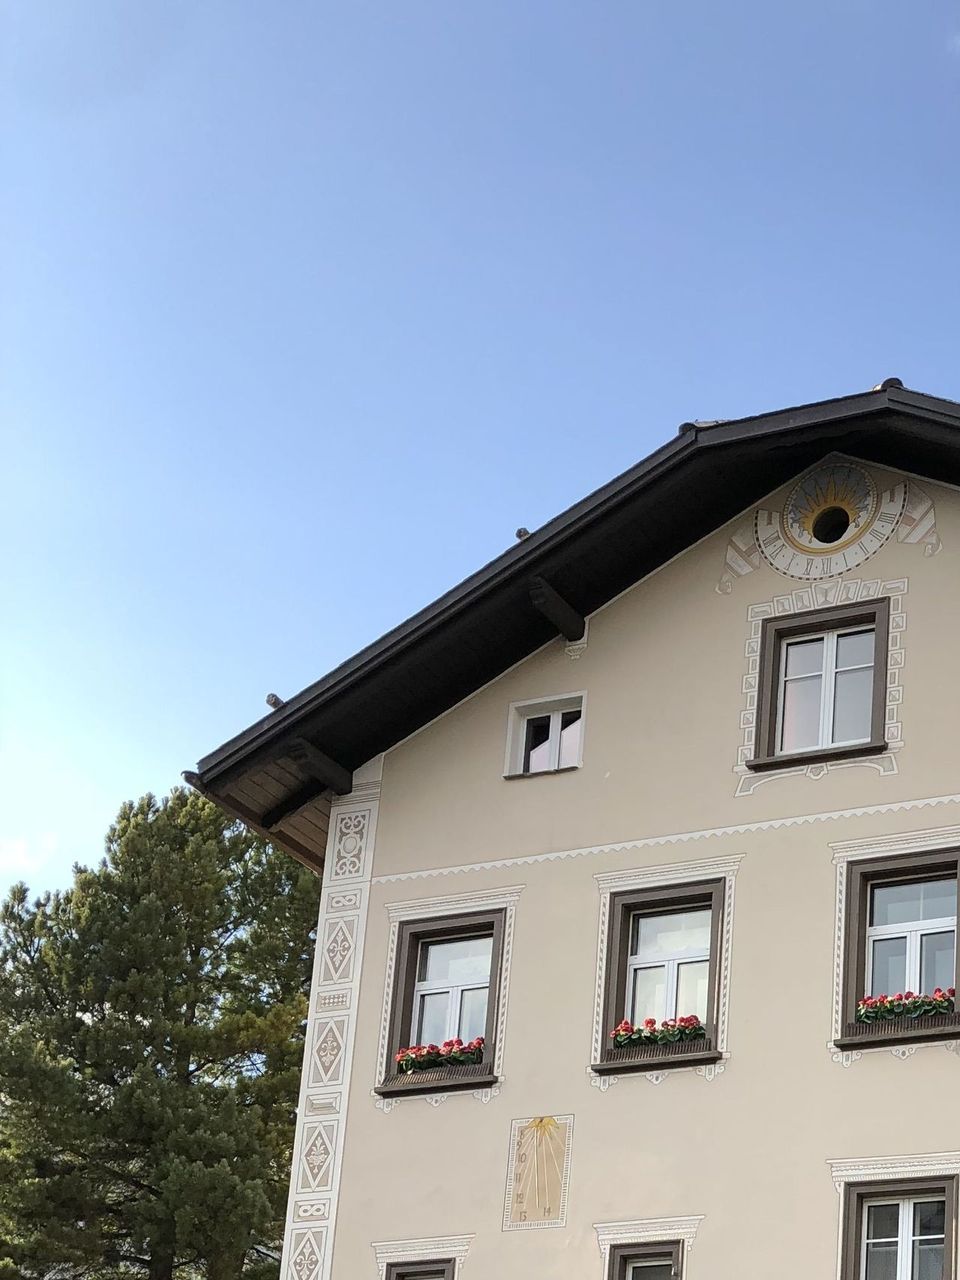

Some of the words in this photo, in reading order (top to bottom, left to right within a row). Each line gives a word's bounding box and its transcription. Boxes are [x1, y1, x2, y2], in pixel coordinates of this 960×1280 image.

[877, 511, 898, 525] IIII
[869, 528, 886, 542] III
[858, 541, 870, 556] II
[518, 1152, 527, 1164] 10
[543, 1206, 552, 1217] 14
